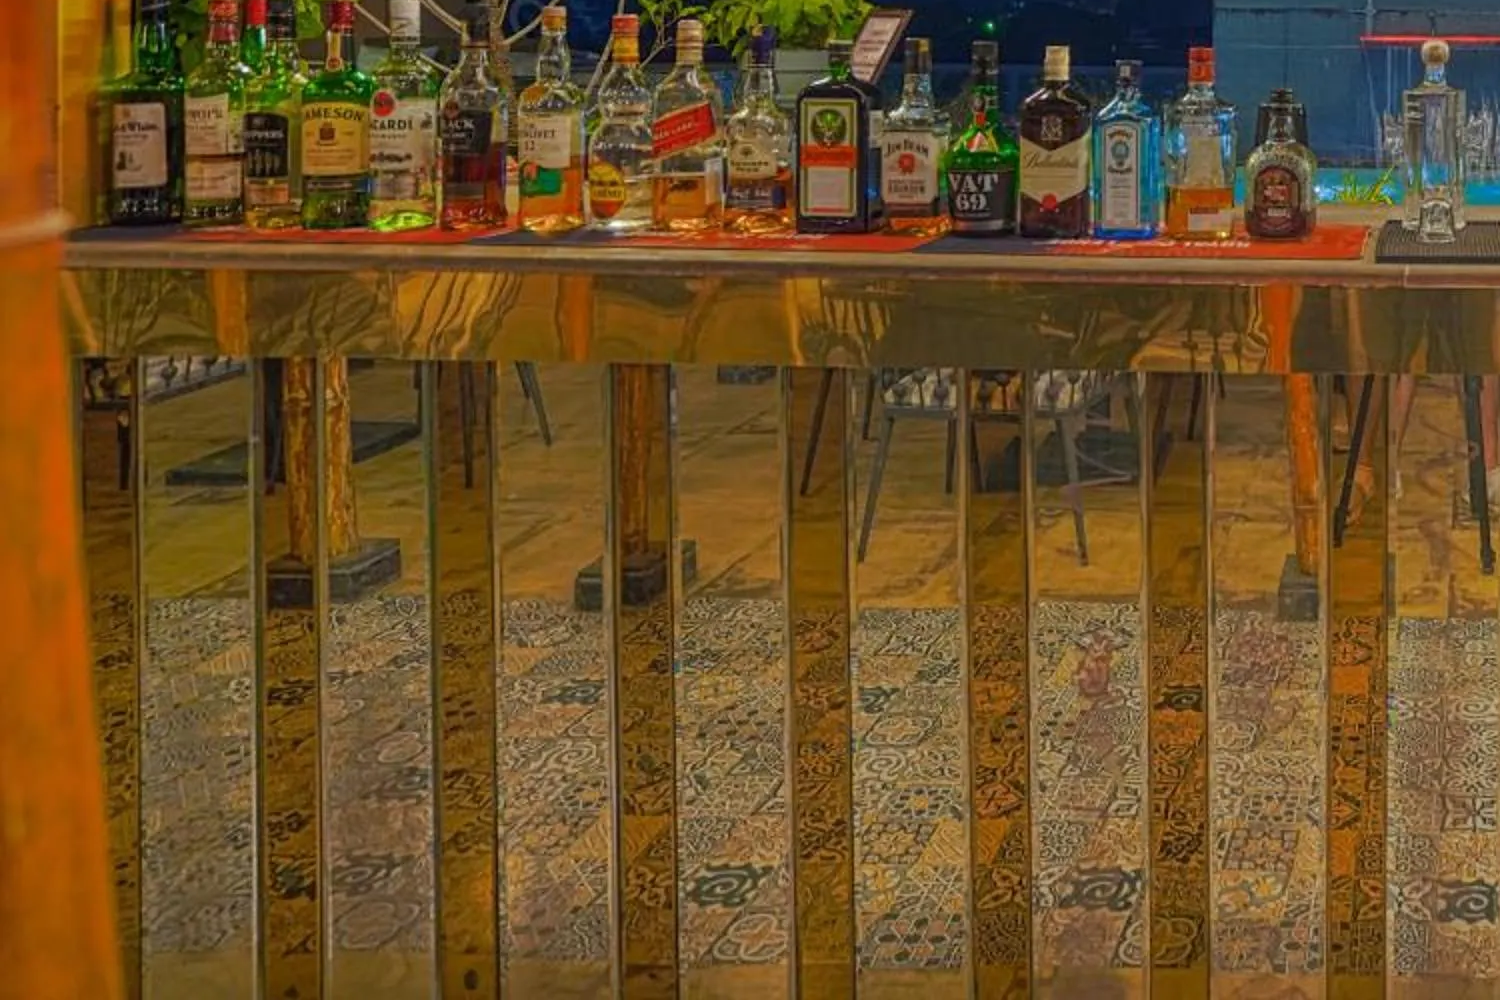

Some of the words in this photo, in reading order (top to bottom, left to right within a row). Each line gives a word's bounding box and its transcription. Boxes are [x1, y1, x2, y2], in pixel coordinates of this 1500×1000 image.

[304, 107, 364, 120] AMESON
[370, 119, 413, 130] CARDI
[948, 173, 999, 193] VAT
[956, 193, 988, 211] 69
